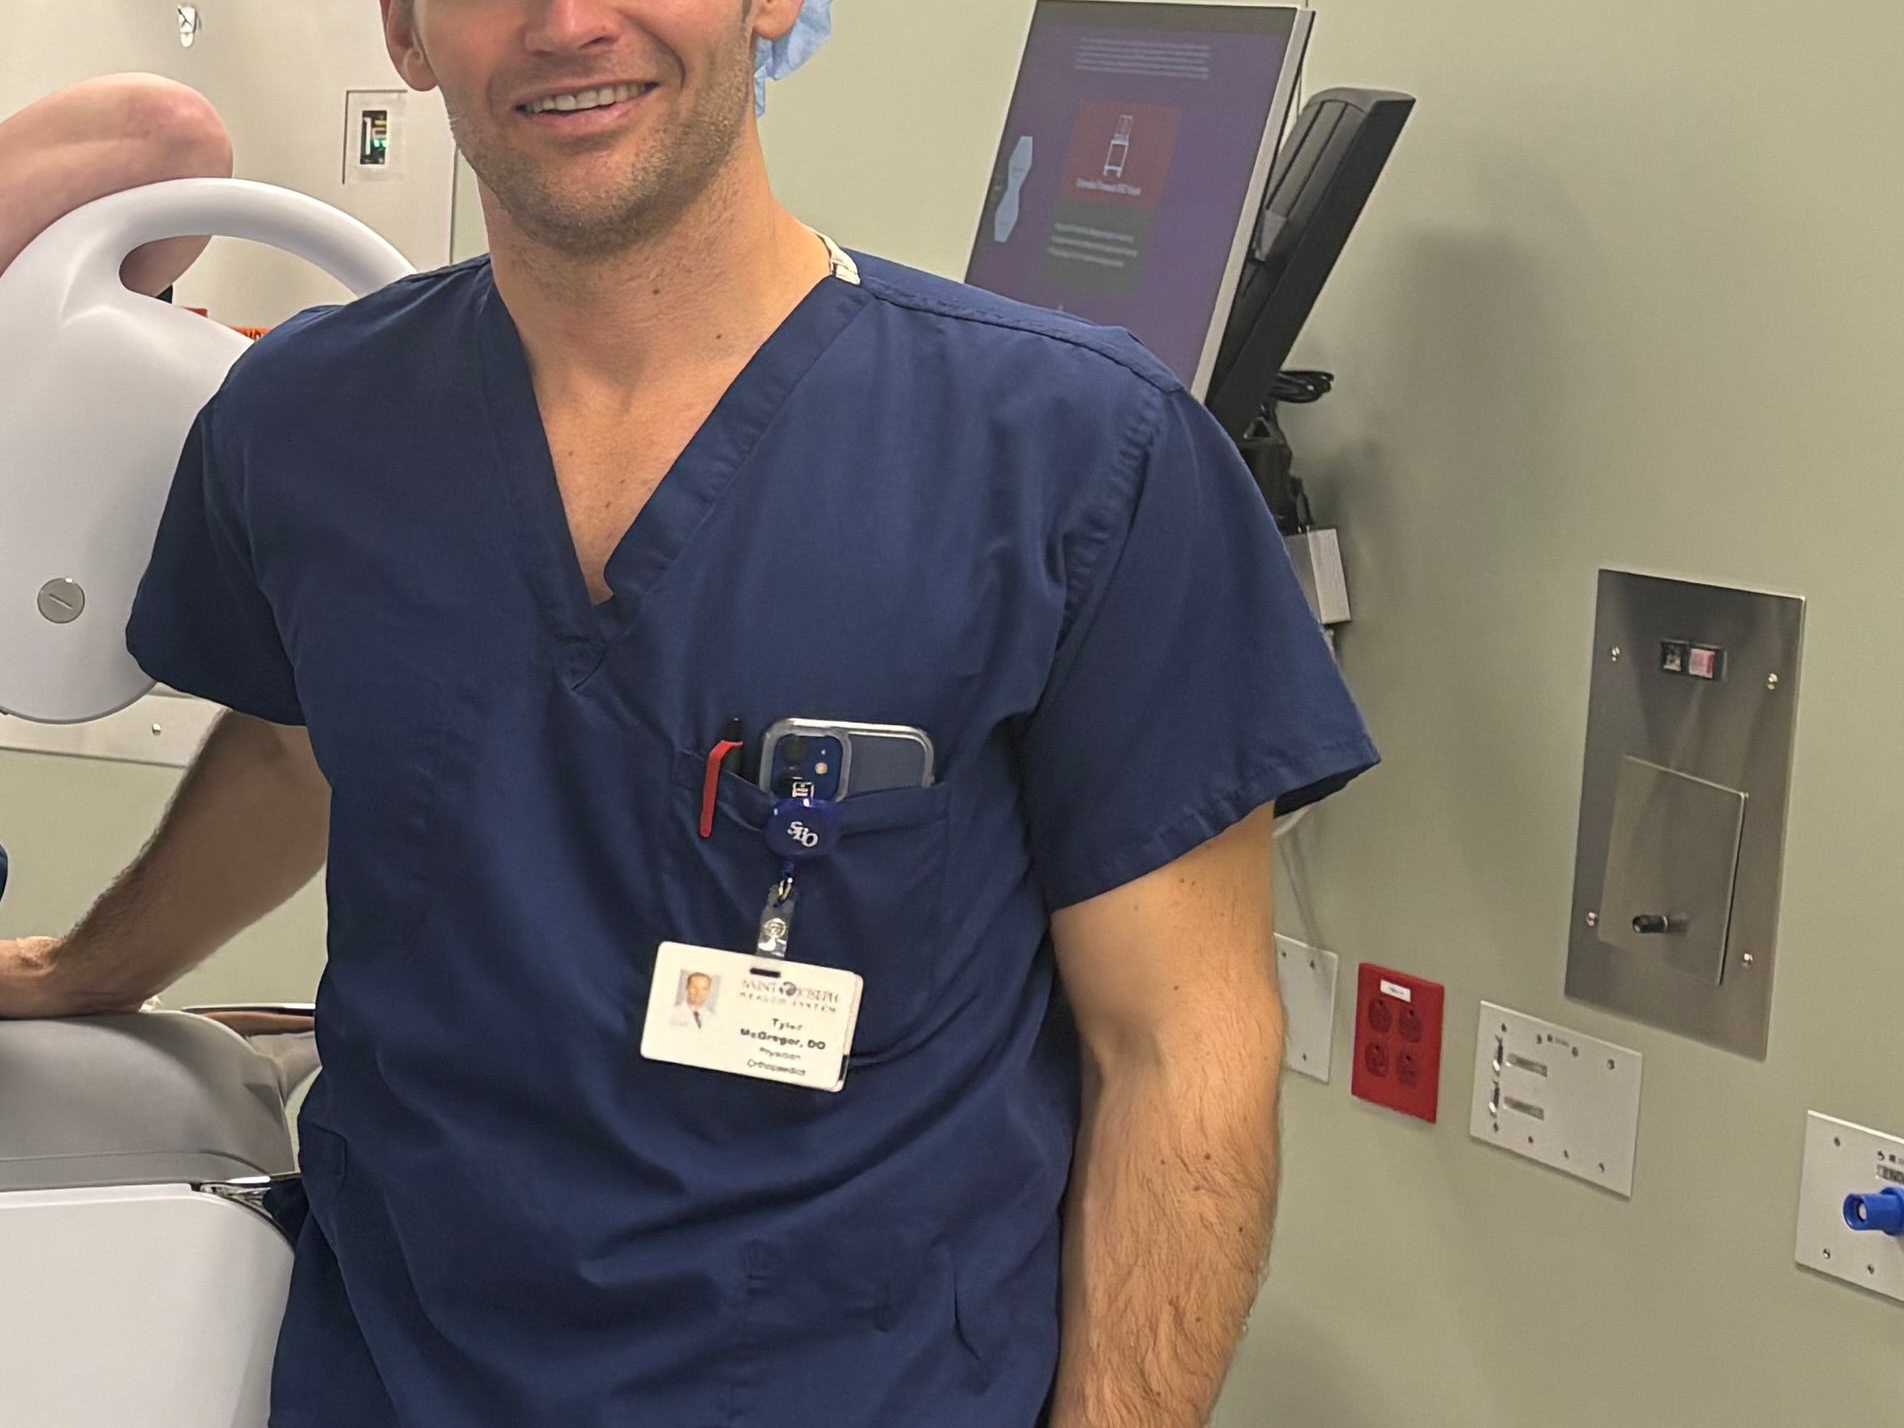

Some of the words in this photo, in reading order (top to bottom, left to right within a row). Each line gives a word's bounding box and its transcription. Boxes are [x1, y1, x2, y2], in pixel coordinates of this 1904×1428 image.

[772, 1018, 803, 1031] Tyler
[740, 1028, 804, 1048] McGregor,
[807, 1039, 827, 1050] DO
